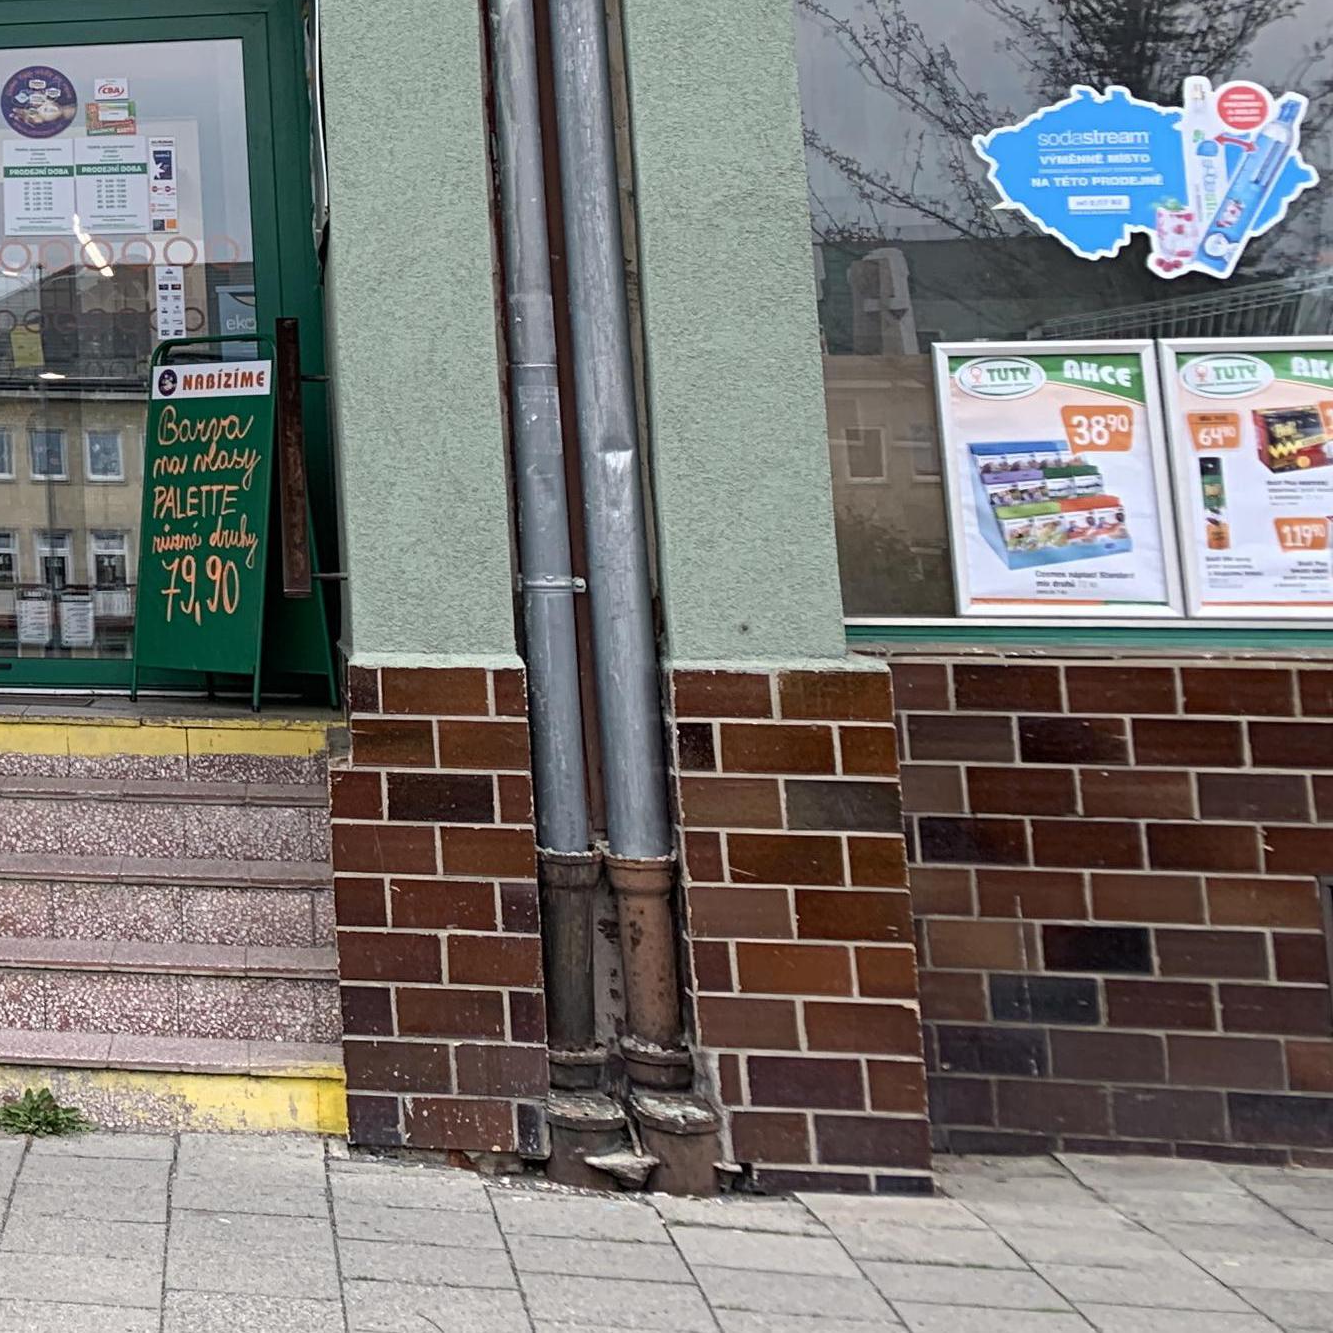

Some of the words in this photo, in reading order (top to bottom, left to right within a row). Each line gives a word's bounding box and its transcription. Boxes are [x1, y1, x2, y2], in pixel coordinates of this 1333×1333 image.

[1038, 130, 1149, 146] sodastream
[9, 166, 47, 176] PRODEJNÍ
[48, 168, 70, 176] DOBA
[82, 164, 120, 174] PRODEJNÍ
[1031, 178, 1050, 187] NA
[1054, 176, 1089, 187] TÉTO
[183, 368, 265, 391] NABÍZÍME
[986, 367, 1032, 382] TUTY
[1063, 359, 1132, 388] AKCE
[1213, 365, 1258, 381] TUTY
[1291, 356, 1333, 380] AK
[158, 405, 254, 445] Barva
[153, 454, 188, 479] na
[194, 442, 262, 491] vlasy
[153, 485, 240, 519] PALETTE
[209, 513, 259, 570] druhy
[161, 555, 240, 627] 79,90
